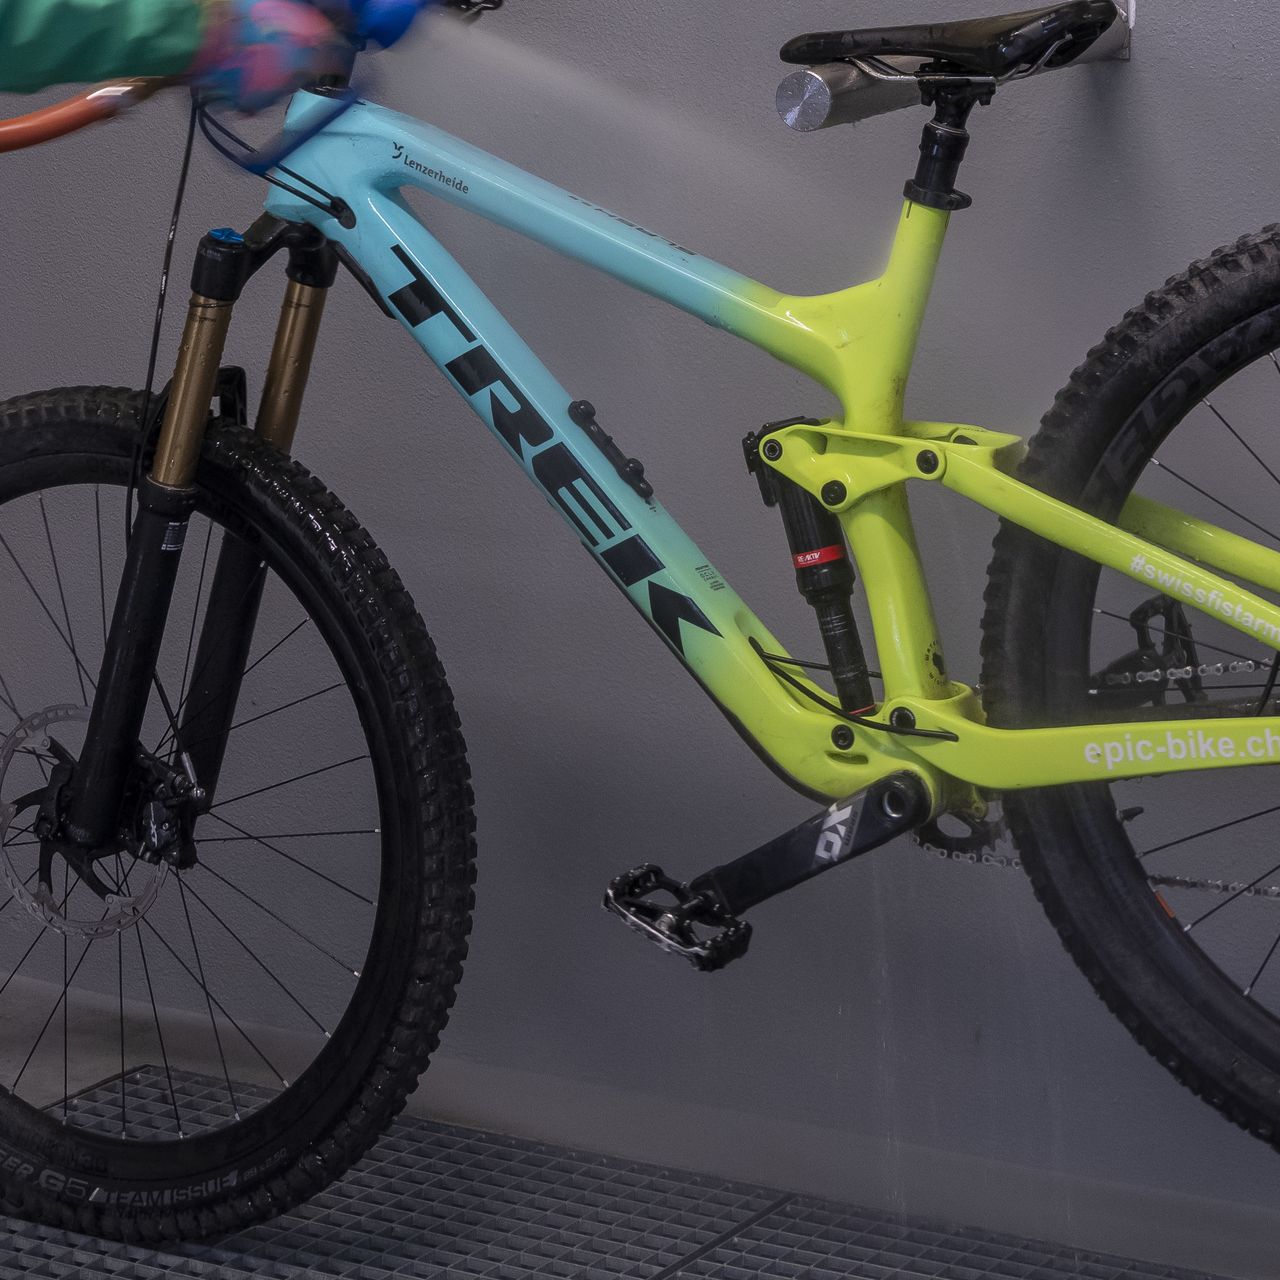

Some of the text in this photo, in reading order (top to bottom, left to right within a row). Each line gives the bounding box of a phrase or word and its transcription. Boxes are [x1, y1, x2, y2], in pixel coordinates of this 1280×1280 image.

[403, 154, 469, 195] Lenzerheide
[388, 243, 725, 658] TREK
[38, 1169, 89, 1199] G5
